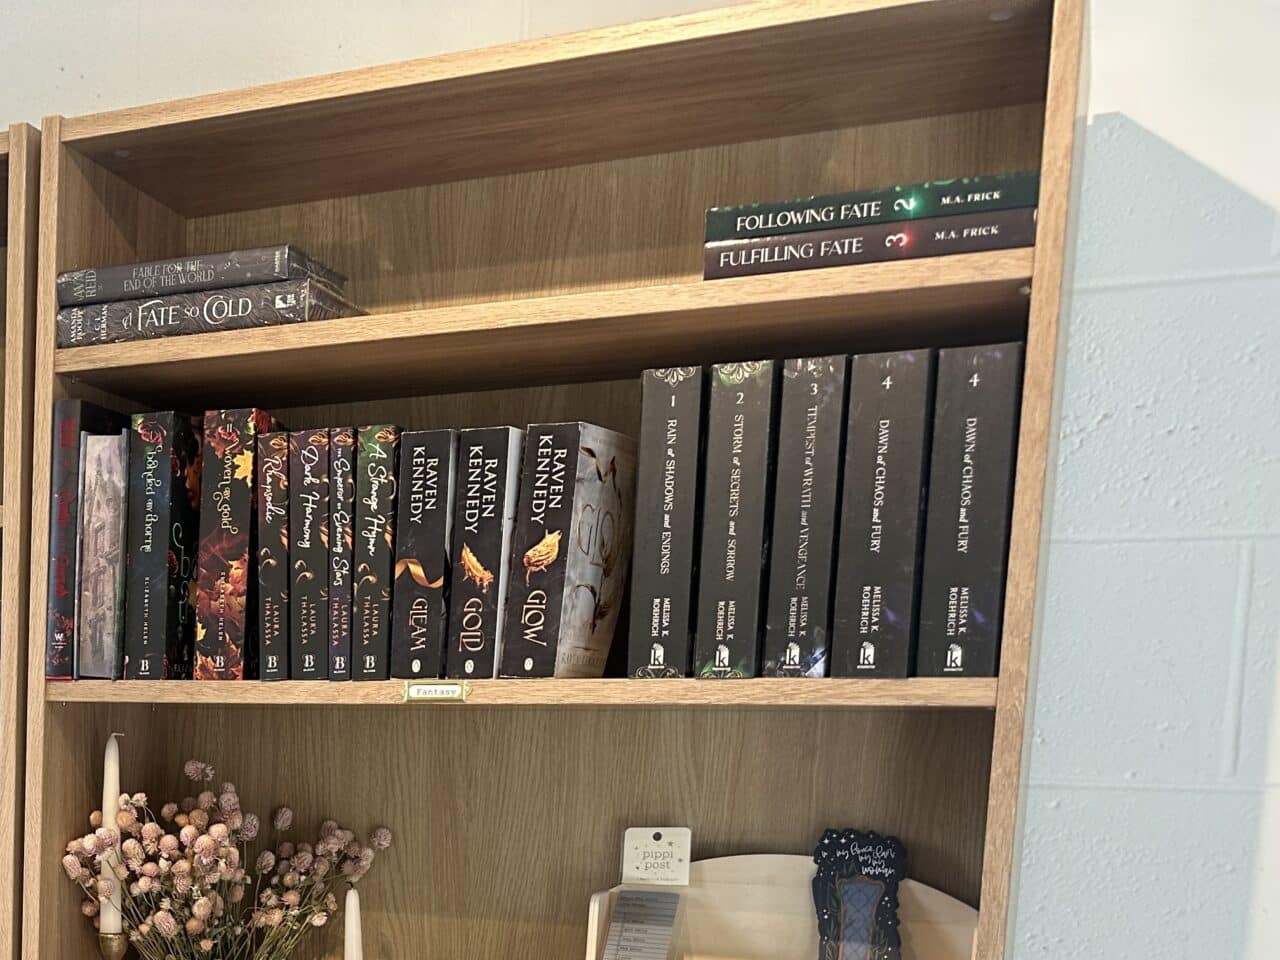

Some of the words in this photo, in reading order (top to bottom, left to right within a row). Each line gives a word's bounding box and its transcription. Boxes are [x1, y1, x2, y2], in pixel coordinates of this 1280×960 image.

[941, 195, 964, 205] M.A.
[967, 191, 1001, 201] FRICK
[736, 208, 834, 231] FOLLOWING
[840, 201, 881, 219] FATE
[719, 243, 814, 267] FULFILLING
[820, 238, 863, 256] FATE
[86, 270, 96, 298] REID
[124, 279, 141, 292] END
[143, 277, 158, 289] OF
[161, 274, 178, 286] THE
[179, 270, 214, 285] WORLD
[138, 300, 180, 330] FATE
[203, 296, 252, 324] COLD
[881, 376, 893, 390] 4
[666, 418, 678, 445] RAIN
[878, 419, 890, 454] DAWN
[368, 443, 387, 458] A
[300, 446, 319, 490] Dark
[663, 459, 676, 511] SHADOWS
[362, 462, 387, 513] Strange
[464, 446, 484, 534] KENNEDY
[482, 459, 498, 518] RAVEN
[874, 467, 887, 507] CHAOS
[297, 491, 320, 548] Harmony
[872, 508, 880, 522] and
[362, 515, 386, 557] Hymn
[660, 531, 671, 574] ENDINGS
[870, 525, 881, 554] FURY
[410, 598, 427, 650] GLEAM
[458, 598, 484, 652] GOLD
[521, 590, 547, 647] GLOW
[650, 598, 660, 638] ROEHRICH
[416, 688, 457, 697] Fantasy
[642, 849, 674, 862] pippi
[644, 858, 671, 871] post
